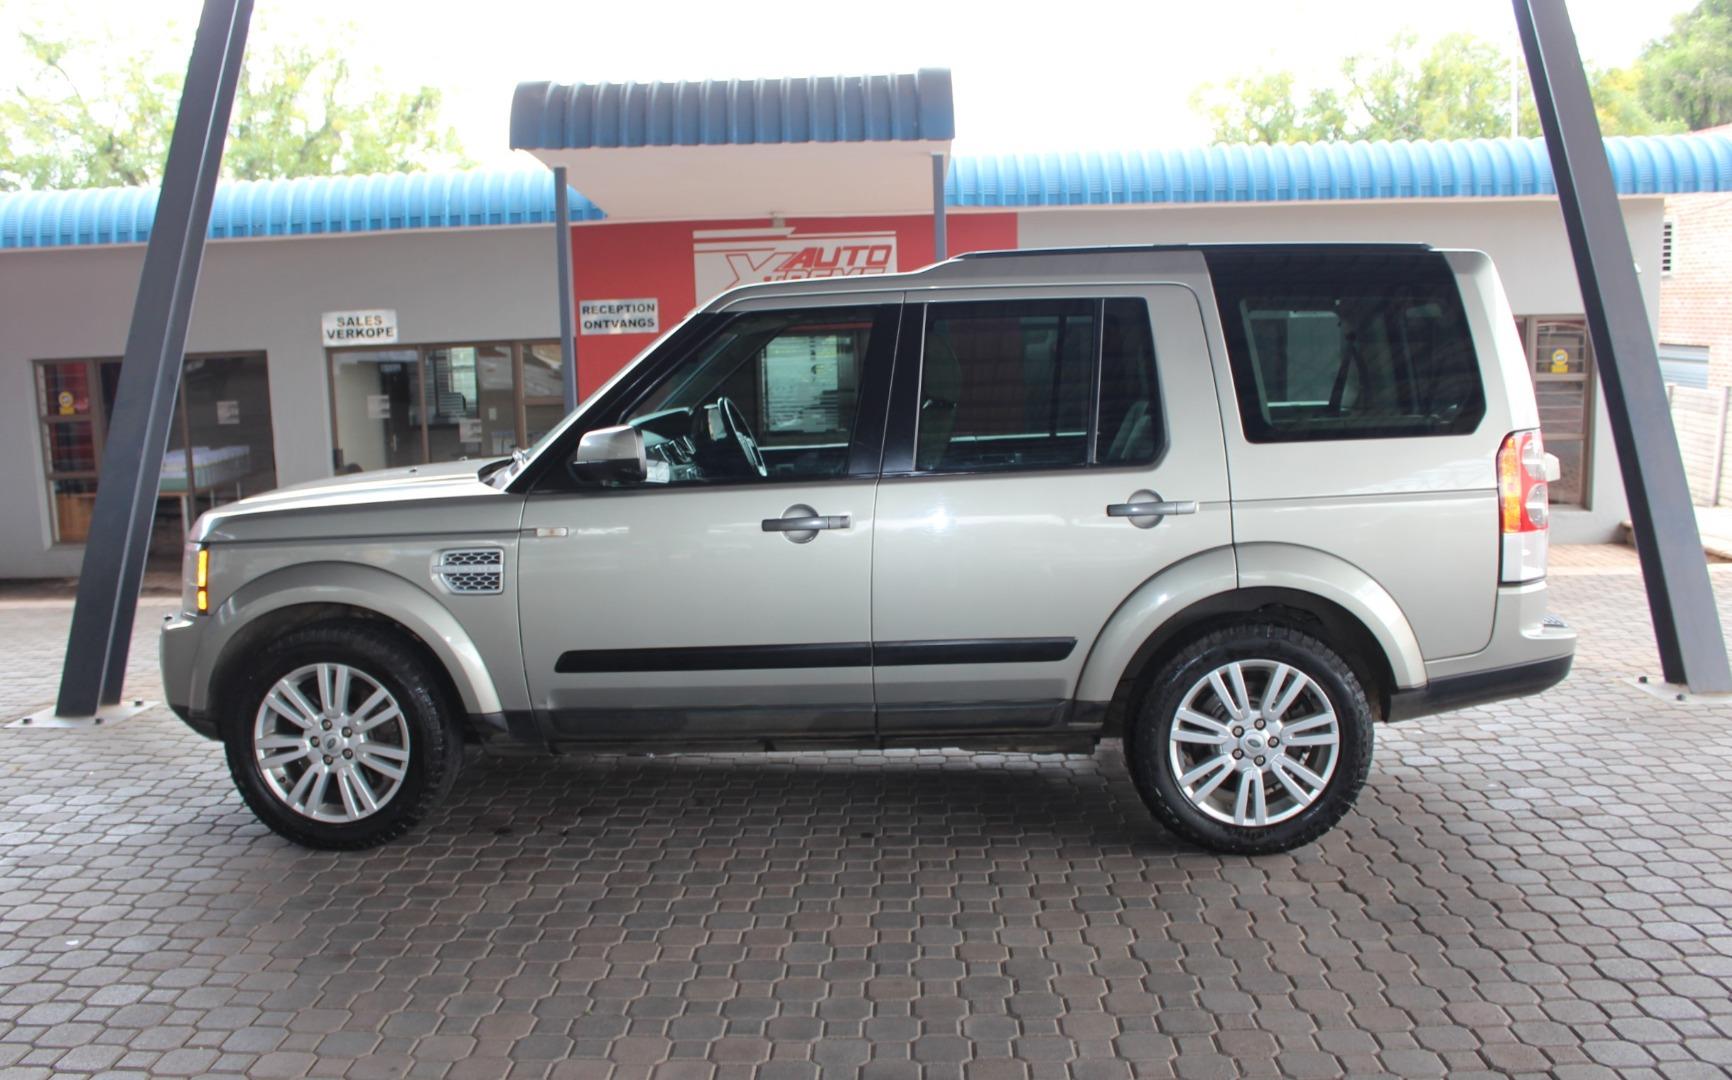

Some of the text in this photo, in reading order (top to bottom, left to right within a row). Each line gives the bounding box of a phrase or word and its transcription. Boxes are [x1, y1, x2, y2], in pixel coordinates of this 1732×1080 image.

[774, 244, 892, 272] AUTO
[582, 303, 656, 315] RECEPTION
[336, 315, 383, 327] SALES
[583, 317, 656, 330] ONTVANGS
[326, 326, 394, 339] VERKOPE
